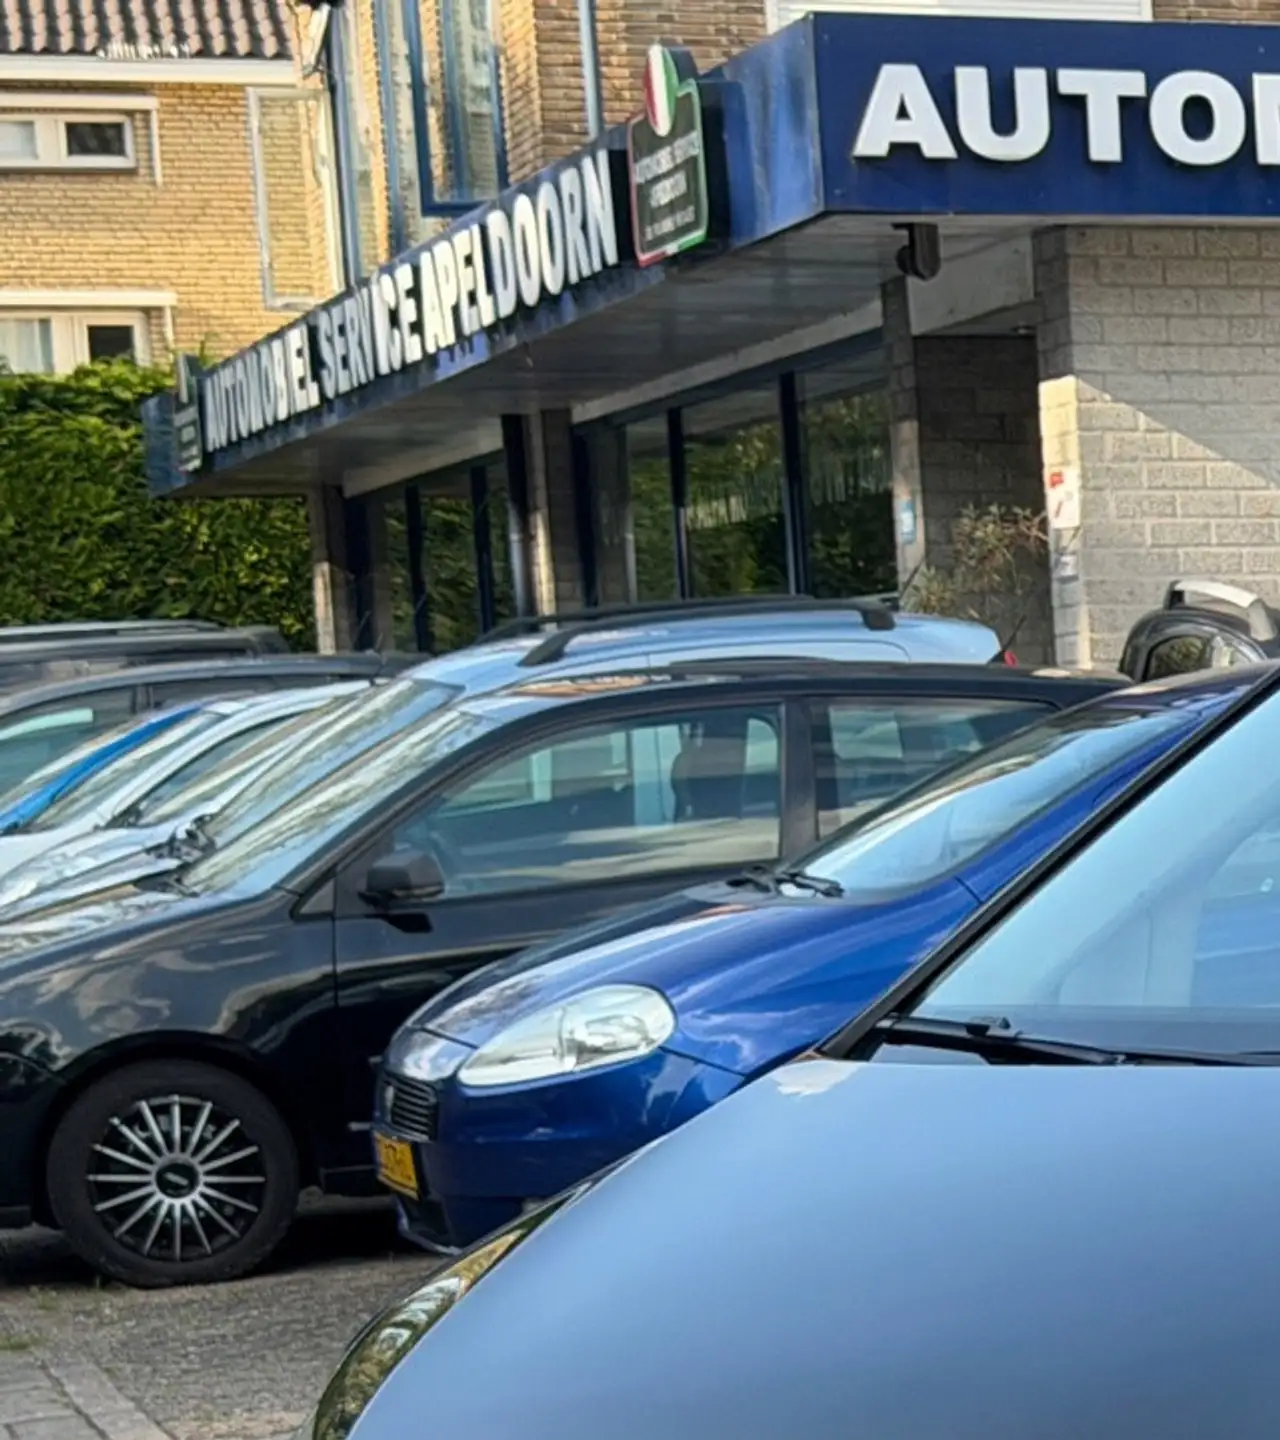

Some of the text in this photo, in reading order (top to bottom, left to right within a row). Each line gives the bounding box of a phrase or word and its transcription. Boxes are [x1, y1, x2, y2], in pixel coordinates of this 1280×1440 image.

[206, 148, 618, 453] AUTOMOBIEL SERVICE APELDOORN
